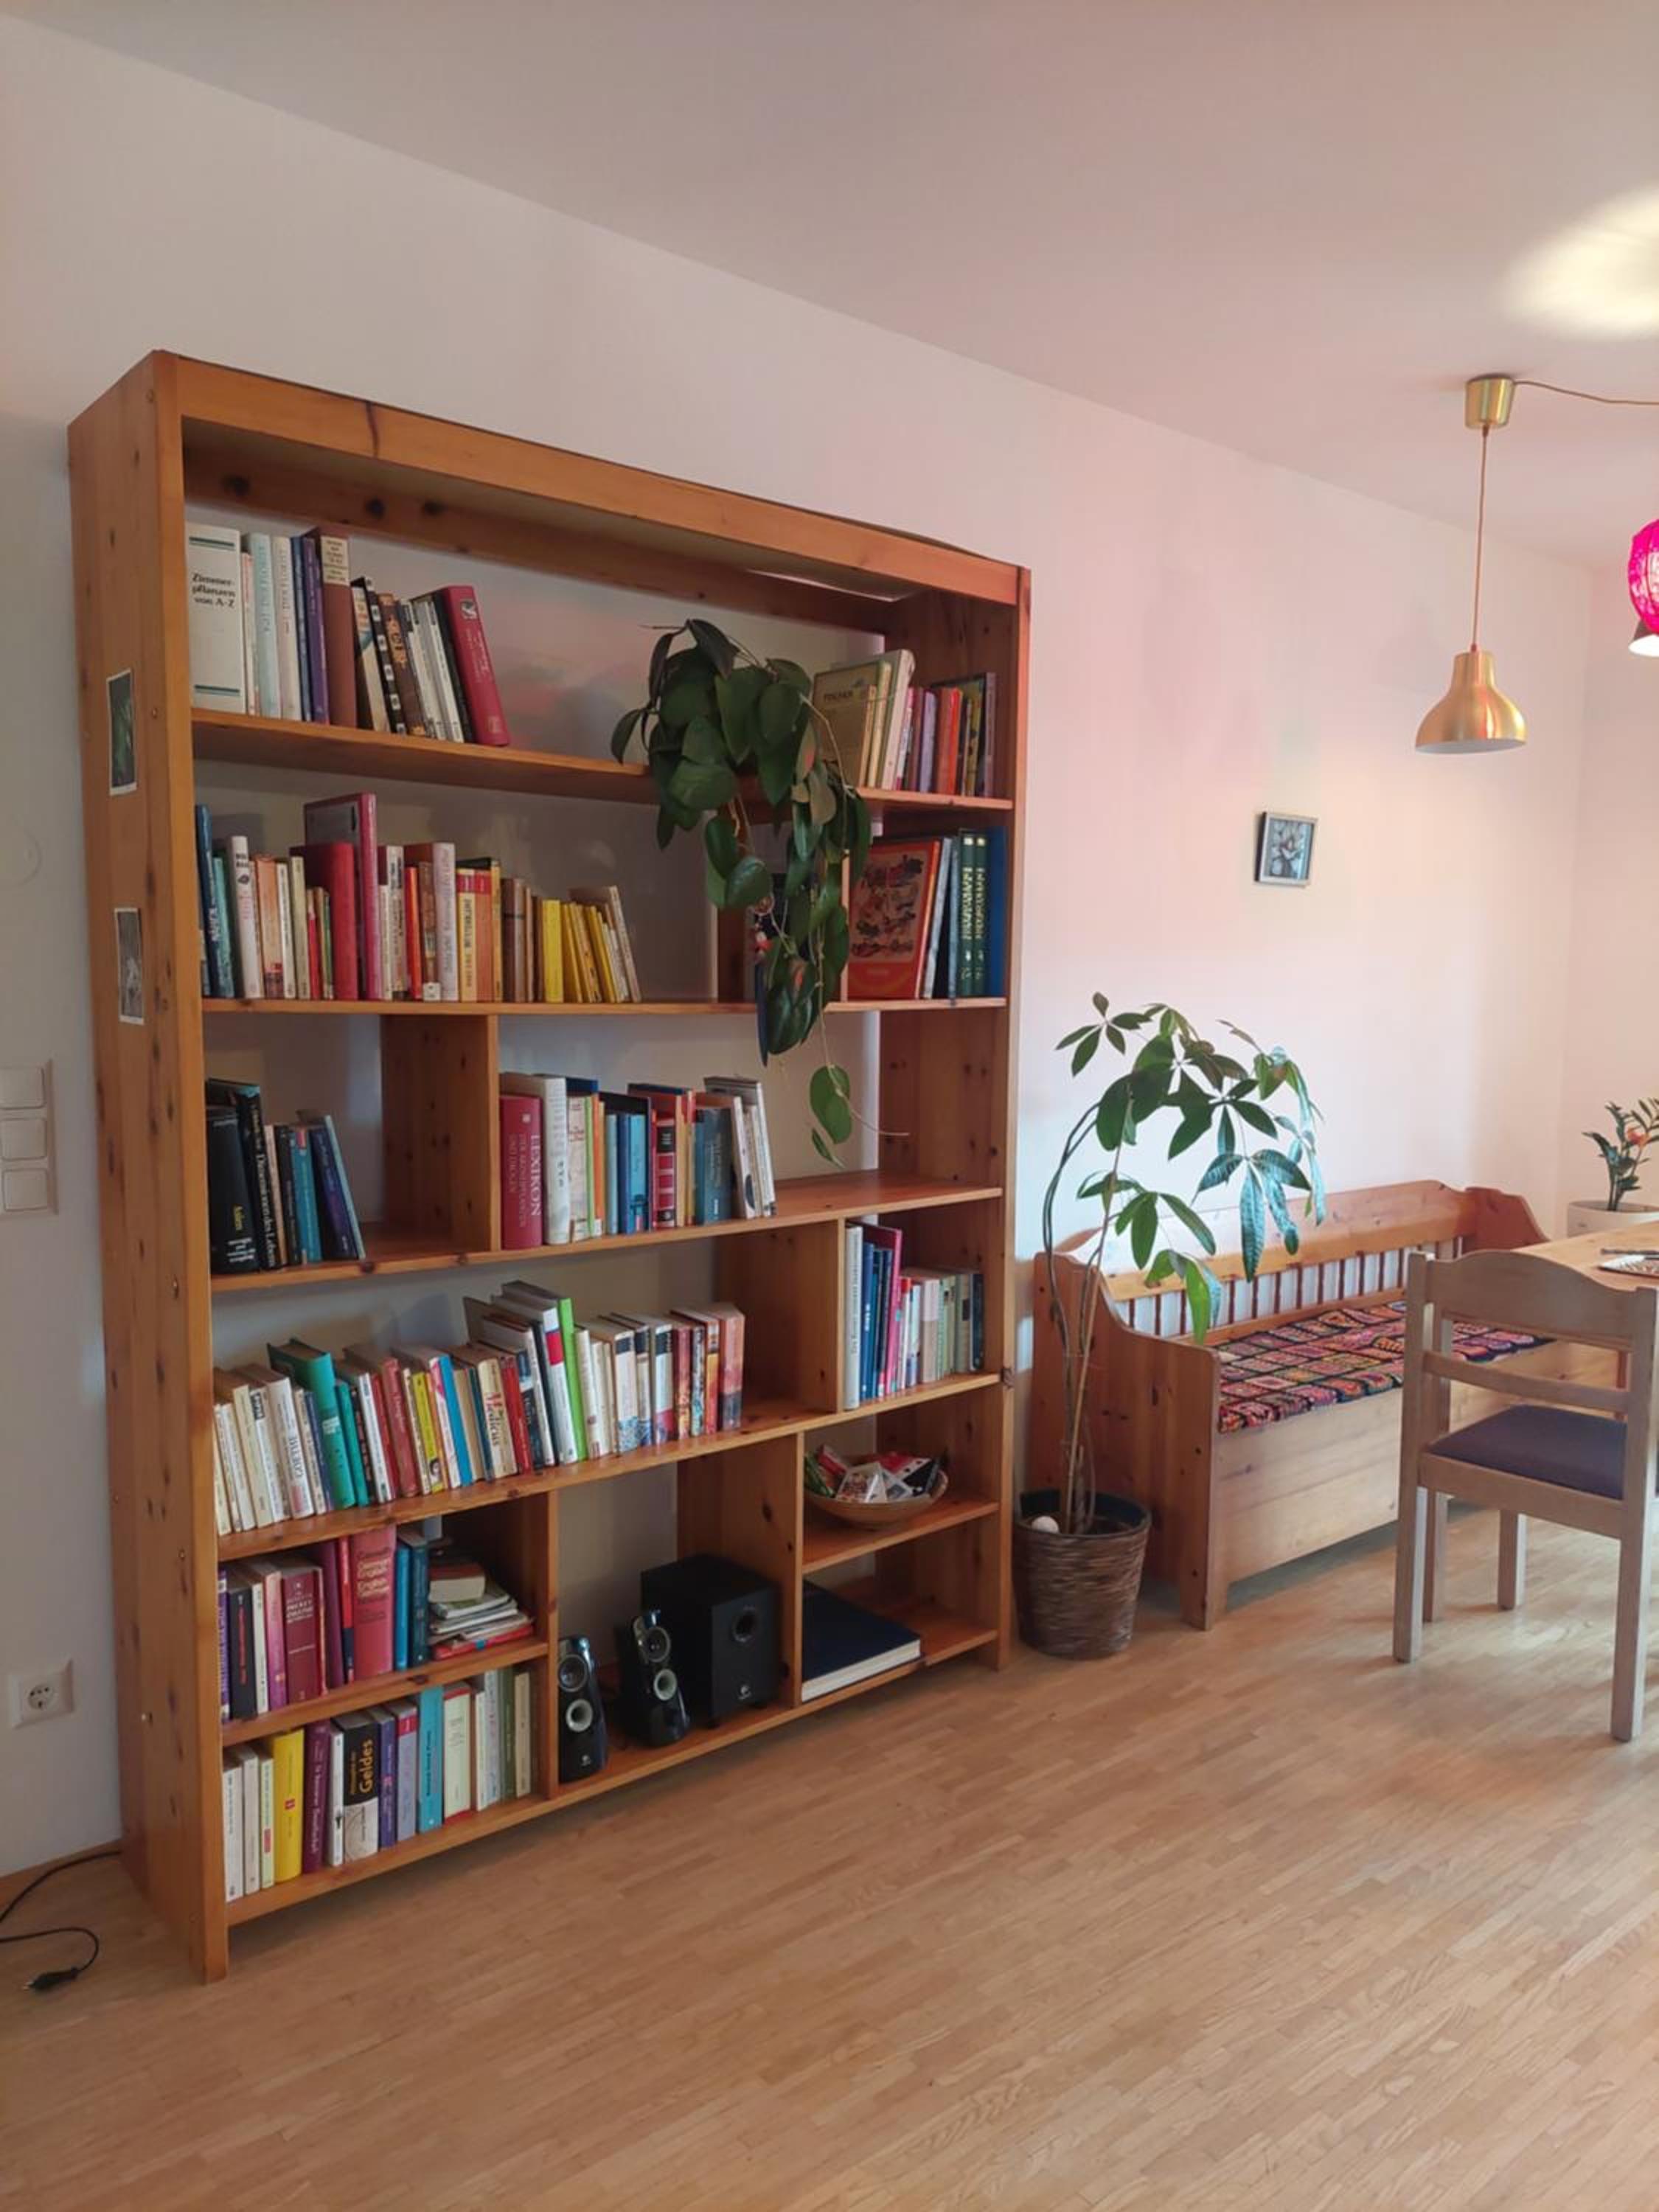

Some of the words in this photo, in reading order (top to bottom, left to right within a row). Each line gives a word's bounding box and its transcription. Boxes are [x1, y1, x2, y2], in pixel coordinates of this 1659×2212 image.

[192, 573, 234, 585] Zimmer-
[192, 584, 236, 597] pflanzen
[194, 597, 213, 605] von
[215, 597, 235, 608] A-Z
[530, 1135, 540, 1216] LEXIKON
[358, 1738, 374, 1795] Geldes
